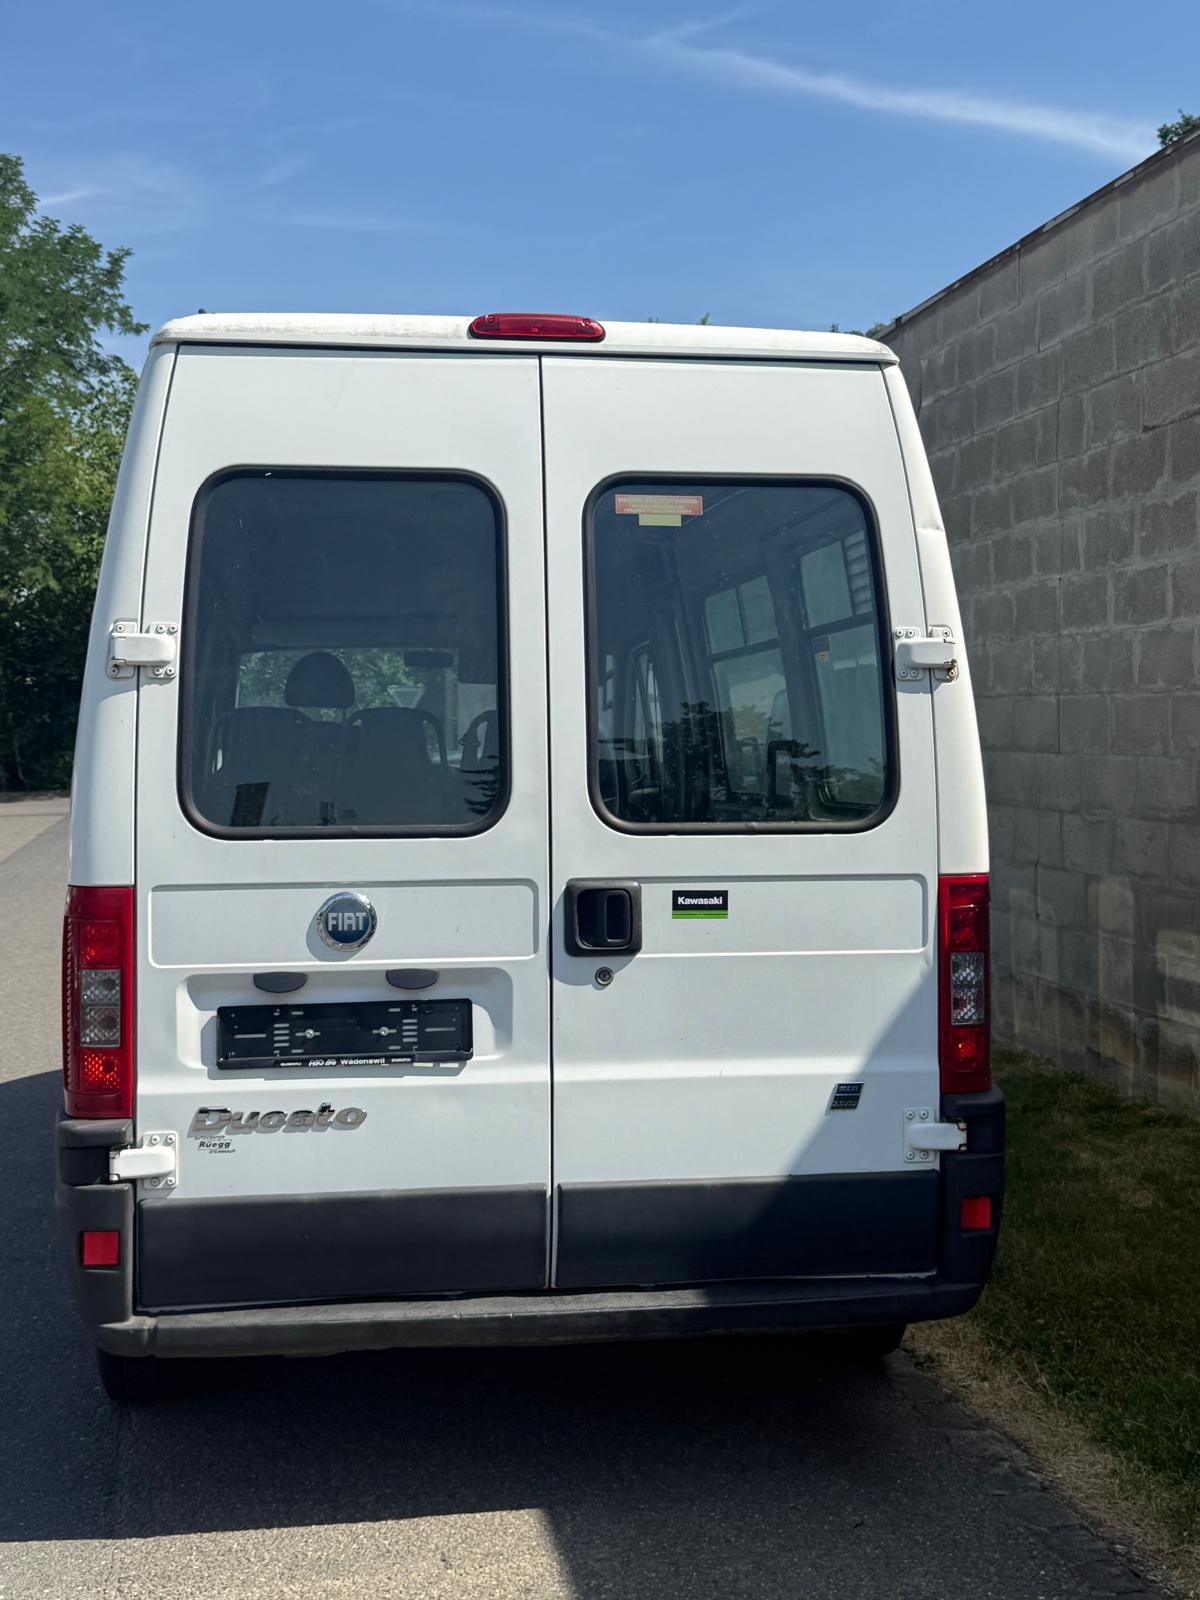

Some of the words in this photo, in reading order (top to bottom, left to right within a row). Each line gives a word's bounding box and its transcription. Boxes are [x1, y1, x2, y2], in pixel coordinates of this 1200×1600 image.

[677, 896, 723, 905] Kawasaki
[327, 912, 367, 931] FIAT
[193, 1101, 368, 1131] Ducato
[198, 1140, 231, 1149] Rüegg
